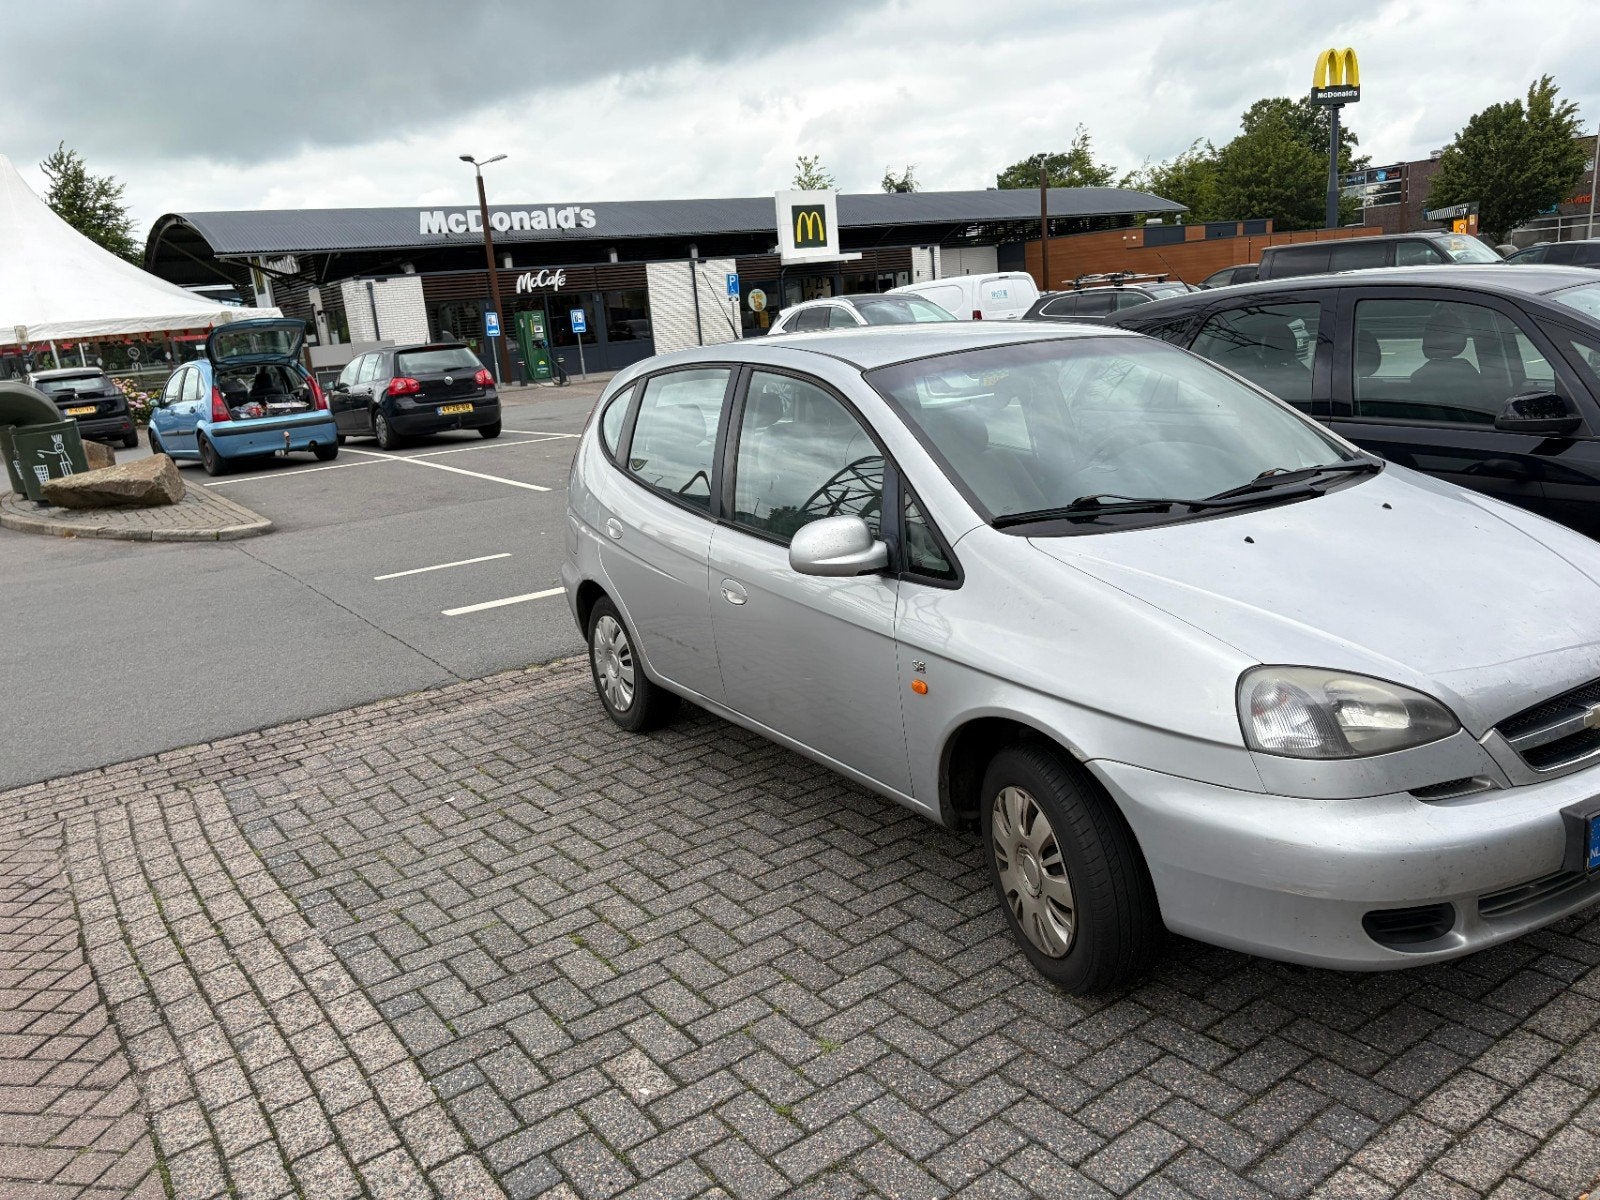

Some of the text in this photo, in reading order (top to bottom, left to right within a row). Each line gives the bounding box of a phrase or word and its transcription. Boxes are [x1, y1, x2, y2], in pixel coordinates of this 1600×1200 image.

[1317, 90, 1358, 99] McDonald's
[419, 206, 597, 235] McDonald's
[516, 268, 567, 294] McCafé
[729, 275, 736, 287] P
